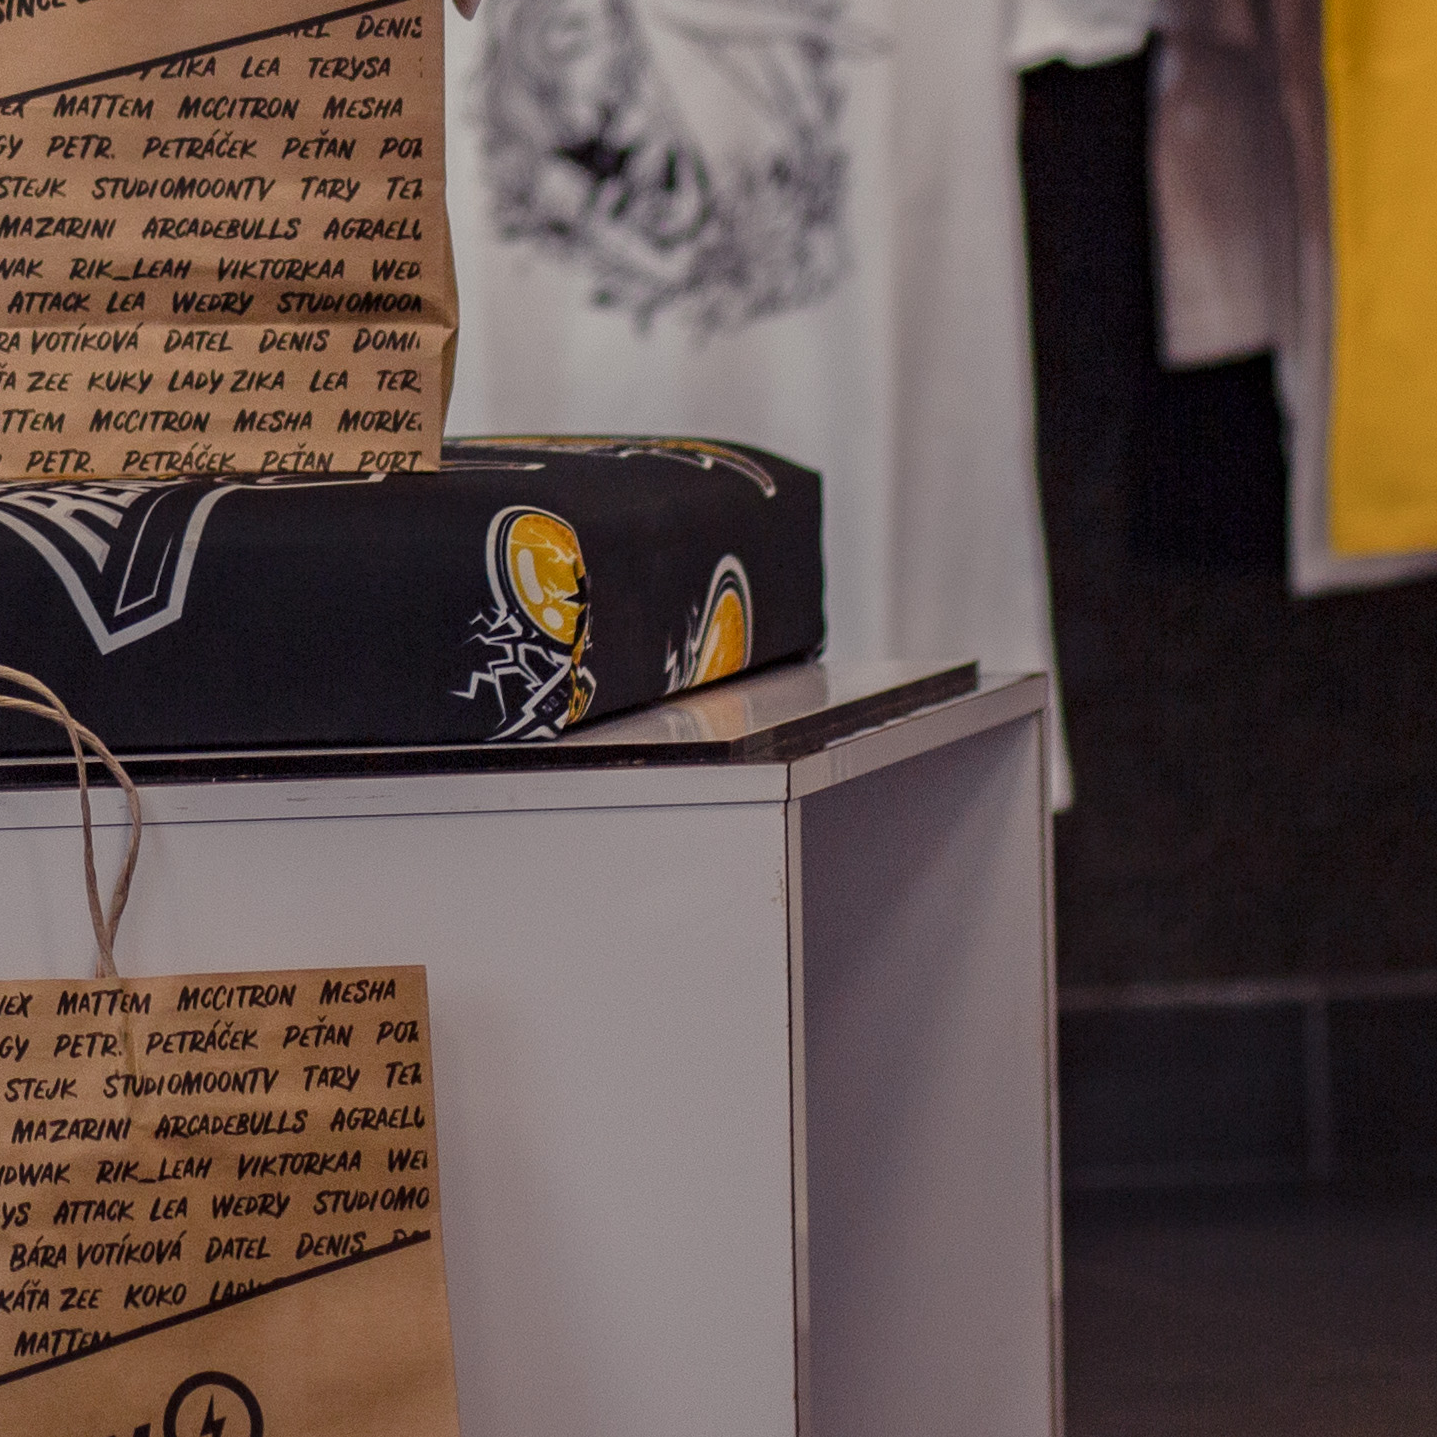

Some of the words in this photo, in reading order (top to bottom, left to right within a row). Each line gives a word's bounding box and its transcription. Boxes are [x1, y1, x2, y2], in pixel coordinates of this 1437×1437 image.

[241, 57, 280, 79] LEA
[309, 56, 390, 81] TERYSA
[53, 94, 154, 119] MATTEM
[323, 96, 403, 119] MESHA
[302, 176, 360, 202] TARY
[142, 217, 301, 240] ARCADEBULLS
[218, 257, 344, 281] VIKTORKAA
[164, 330, 232, 353] DATEL
[259, 329, 330, 353] DENIS
[27, 371, 68, 392] ZEE
[88, 370, 153, 394] KUKY
[168, 370, 224, 394] LADY
[230, 370, 284, 393] ZIKA
[309, 370, 348, 392] LEA
[57, 988, 151, 1016] MATTEM
[319, 979, 395, 1005] MESHA
[5, 1078, 77, 1102] STEJK
[304, 1065, 360, 1092] TARY
[238, 1150, 361, 1180] VIKTORKAA
[10, 1236, 66, 1272] BÁRA
[205, 1236, 270, 1264] DATEL
